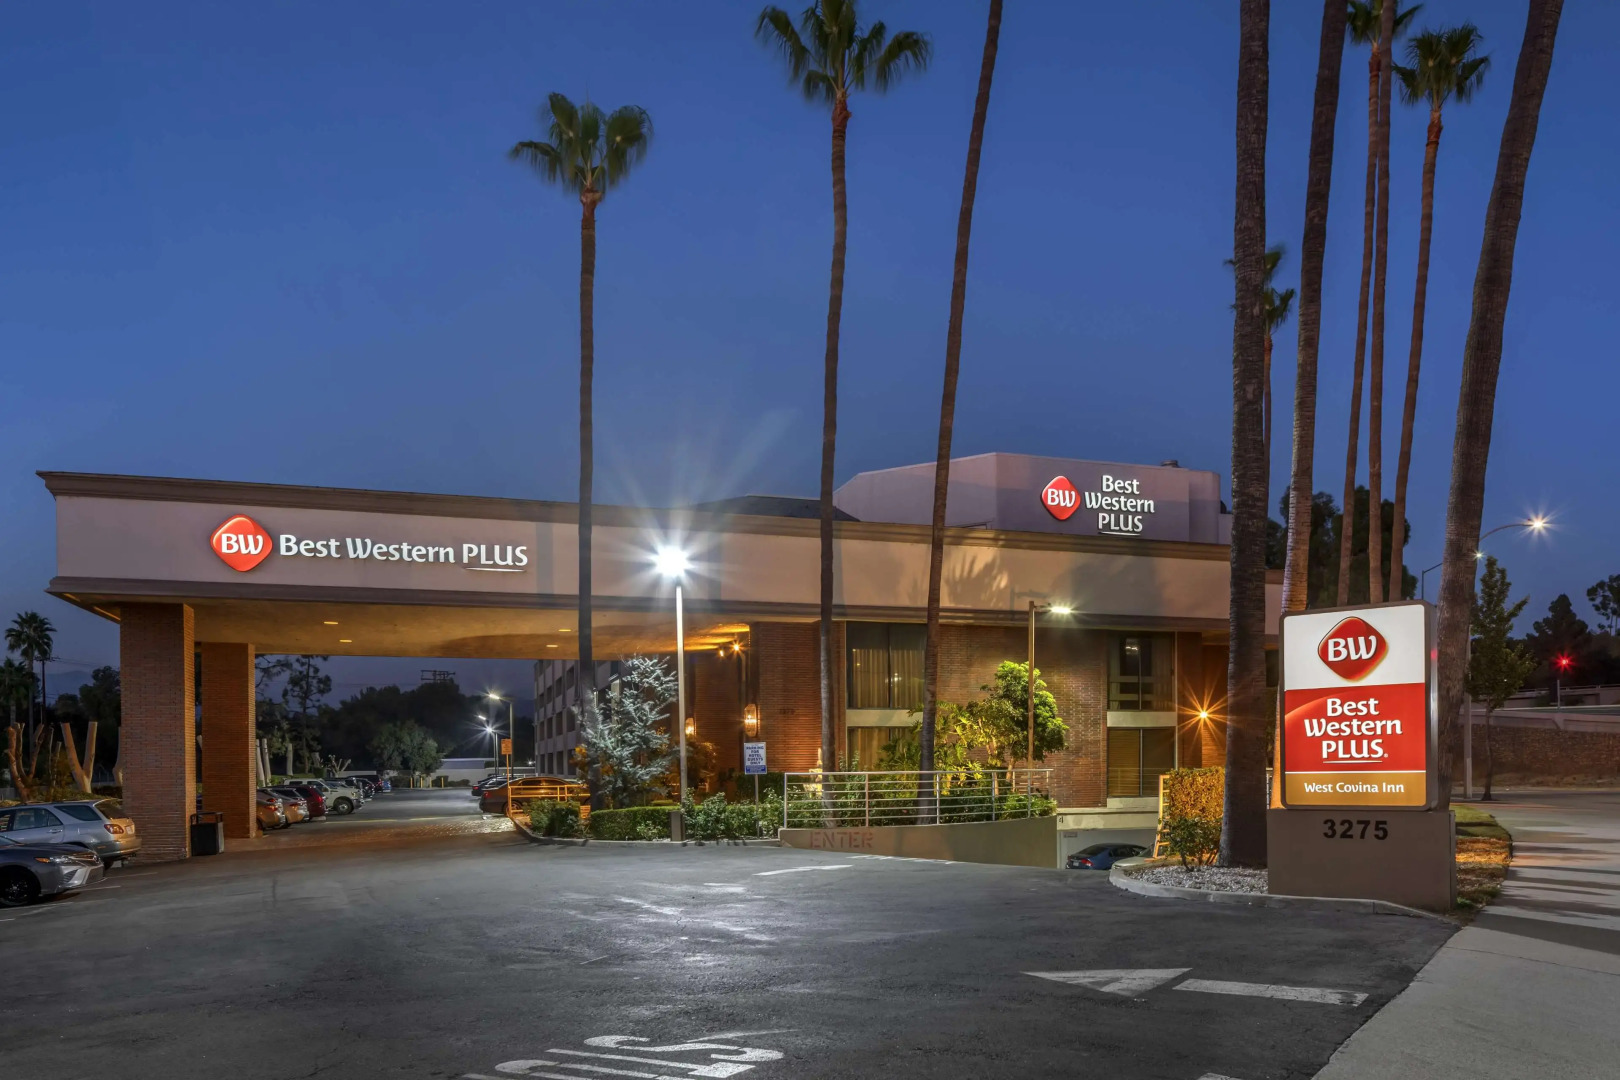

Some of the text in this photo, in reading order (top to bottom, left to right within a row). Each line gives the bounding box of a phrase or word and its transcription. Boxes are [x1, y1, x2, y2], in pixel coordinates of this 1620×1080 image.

[1102, 475, 1140, 495] Best
[1047, 488, 1076, 507] BW
[1084, 491, 1155, 513] Western
[1098, 512, 1143, 532] PLUS
[220, 533, 264, 555] BW
[279, 534, 528, 566] Best Western PLUS
[1327, 635, 1378, 662] BW
[1326, 697, 1380, 717] Best
[1304, 718, 1403, 737] Western
[1304, 782, 1405, 793] West Covina Inn
[810, 831, 873, 848] ENTER
[1322, 819, 1388, 840] 3275
